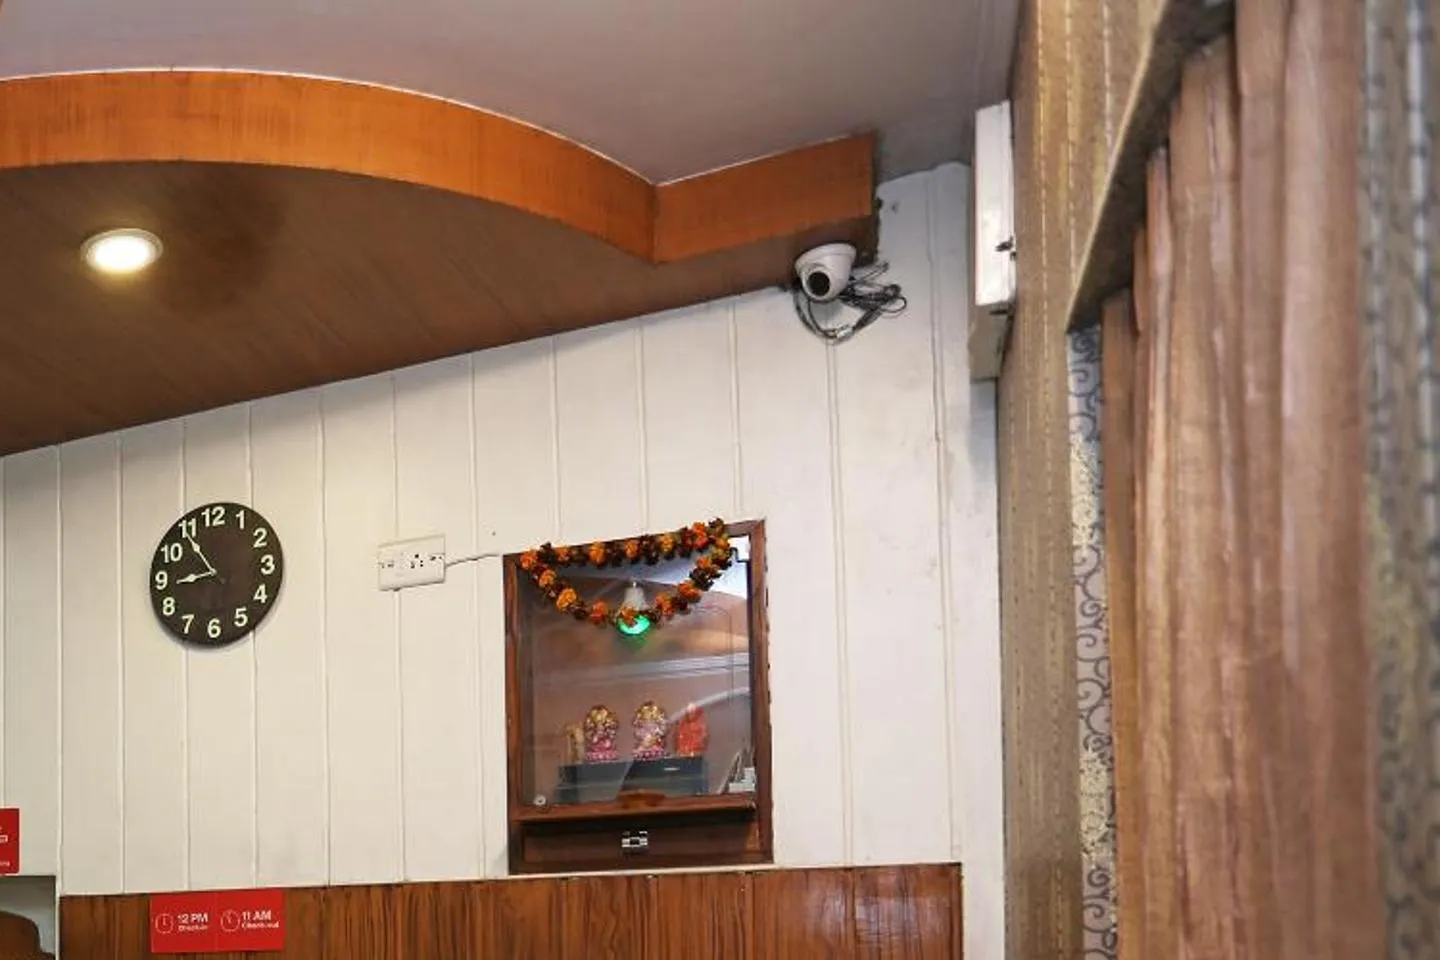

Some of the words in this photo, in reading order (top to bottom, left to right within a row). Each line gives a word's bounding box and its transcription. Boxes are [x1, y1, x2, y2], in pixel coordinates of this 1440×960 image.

[201, 506, 226, 527] 12
[235, 510, 245, 530] 1
[178, 518, 197, 538] 11
[253, 528, 268, 548] 2
[161, 543, 183, 563] 10
[260, 554, 275, 575] 3
[155, 570, 168, 590] 9
[253, 584, 268, 603] 4
[162, 597, 176, 616] 8
[181, 614, 194, 634] 7
[234, 607, 248, 627] 5
[207, 618, 221, 638] 6
[191, 911, 208, 922] PM
[242, 911, 250, 920] 11
[252, 909, 271, 920] AM
